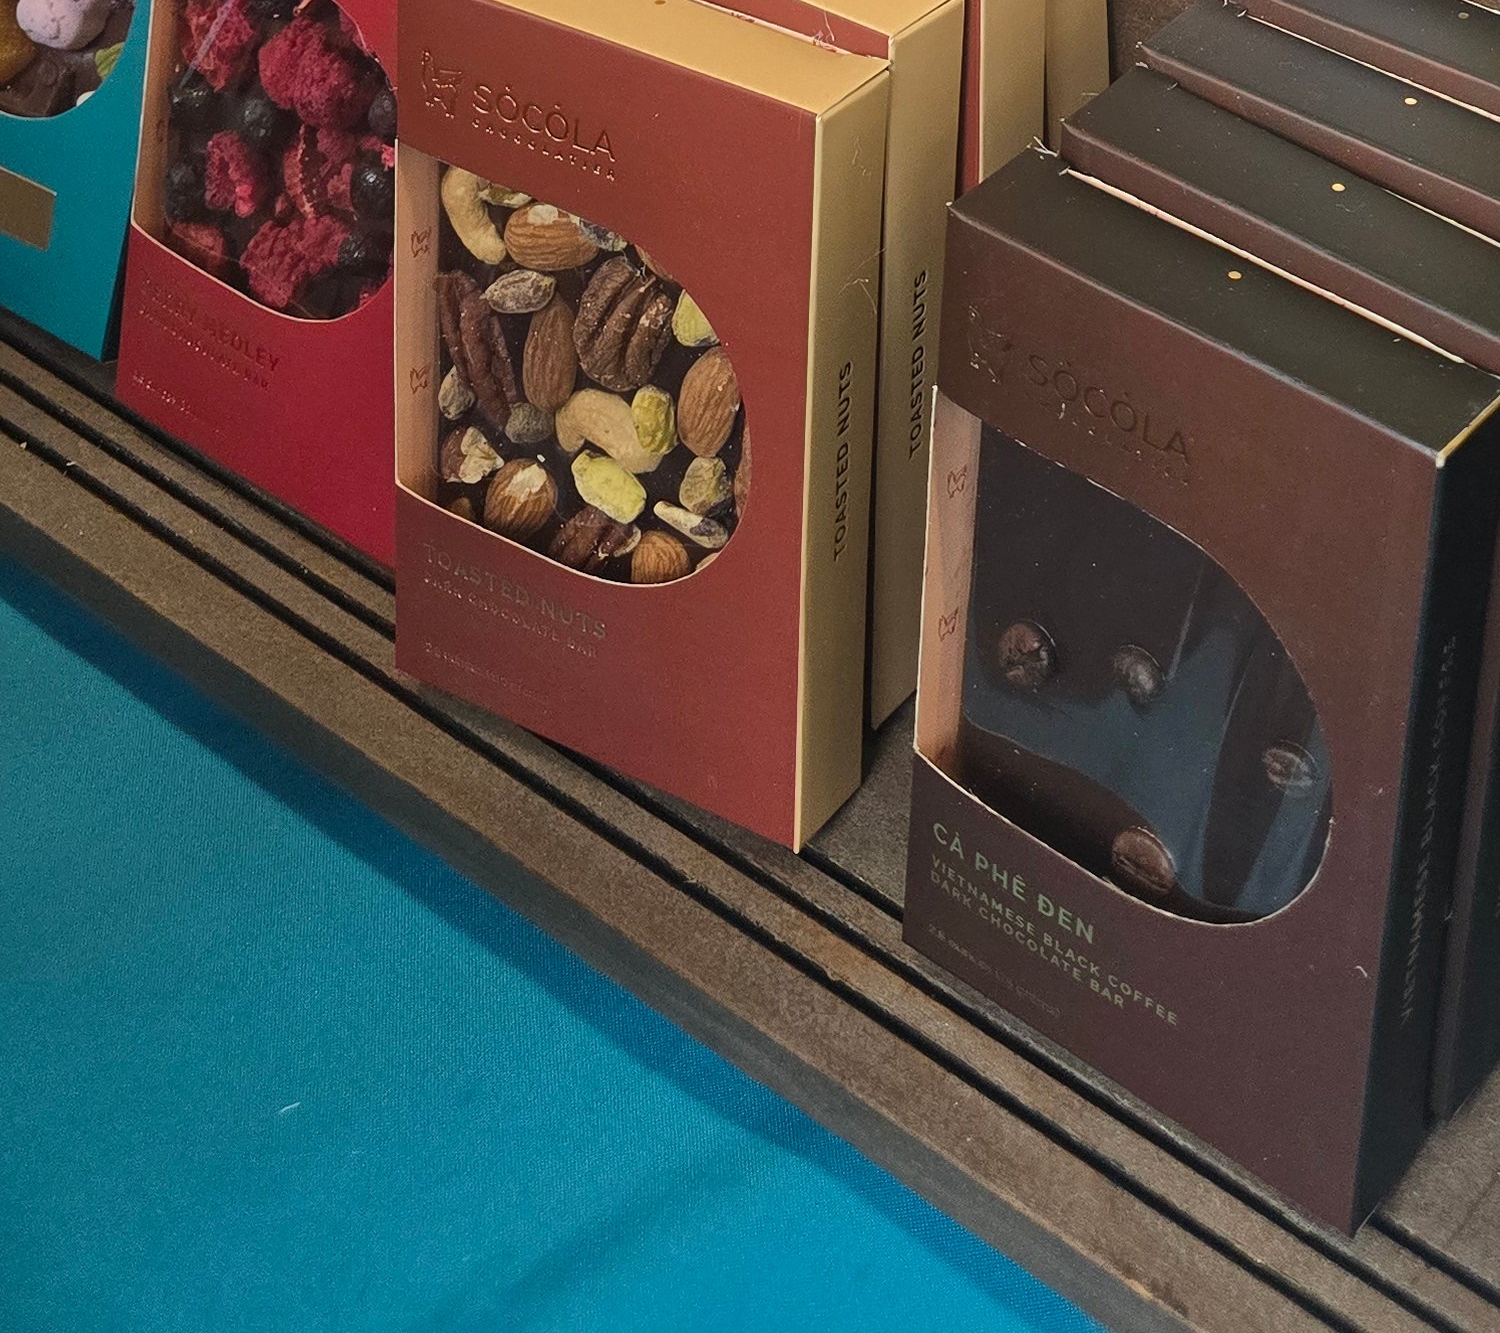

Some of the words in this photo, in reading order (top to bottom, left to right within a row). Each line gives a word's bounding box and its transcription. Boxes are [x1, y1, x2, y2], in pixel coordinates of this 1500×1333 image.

[913, 268, 928, 341] NUTS
[838, 360, 853, 435] NUTS
[909, 347, 925, 461] TOASTED
[833, 442, 850, 563] TOASTED
[422, 542, 532, 607] TOASTED
[539, 595, 607, 638] NUTS
[974, 851, 1027, 902] PHÊ
[930, 869, 973, 911] DARK
[978, 905, 1083, 983] CHOCOLATE
[1090, 979, 1125, 1011] BAR
[931, 854, 1037, 935] VIETNAMESE
[1043, 931, 1100, 979] BLACK
[1107, 974, 1178, 1028] COFFEE
